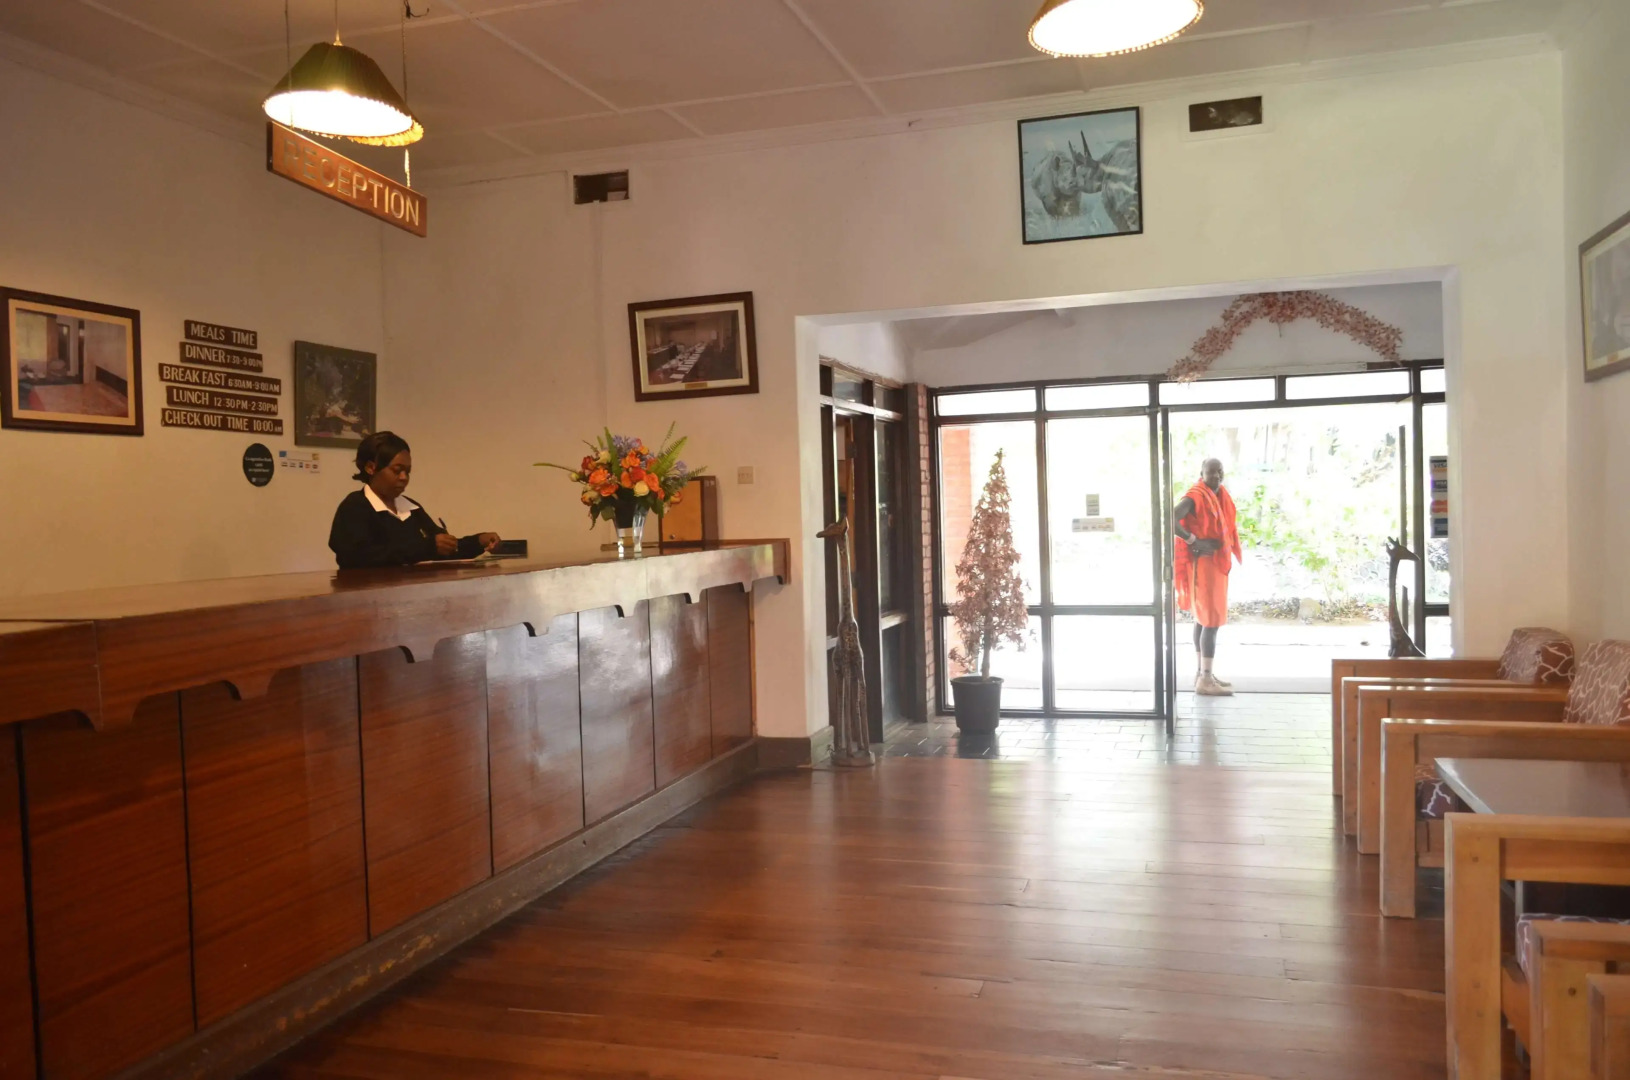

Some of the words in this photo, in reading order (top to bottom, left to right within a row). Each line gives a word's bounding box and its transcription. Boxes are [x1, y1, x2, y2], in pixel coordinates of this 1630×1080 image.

[283, 138, 419, 226] RECEPTION
[190, 323, 225, 340] MEALS
[231, 330, 255, 346] TIME
[185, 344, 226, 363] DINNER
[173, 388, 209, 405] LUNCH
[165, 410, 202, 426] CHECK
[203, 413, 222, 428] OUT
[226, 416, 249, 431] TIME
